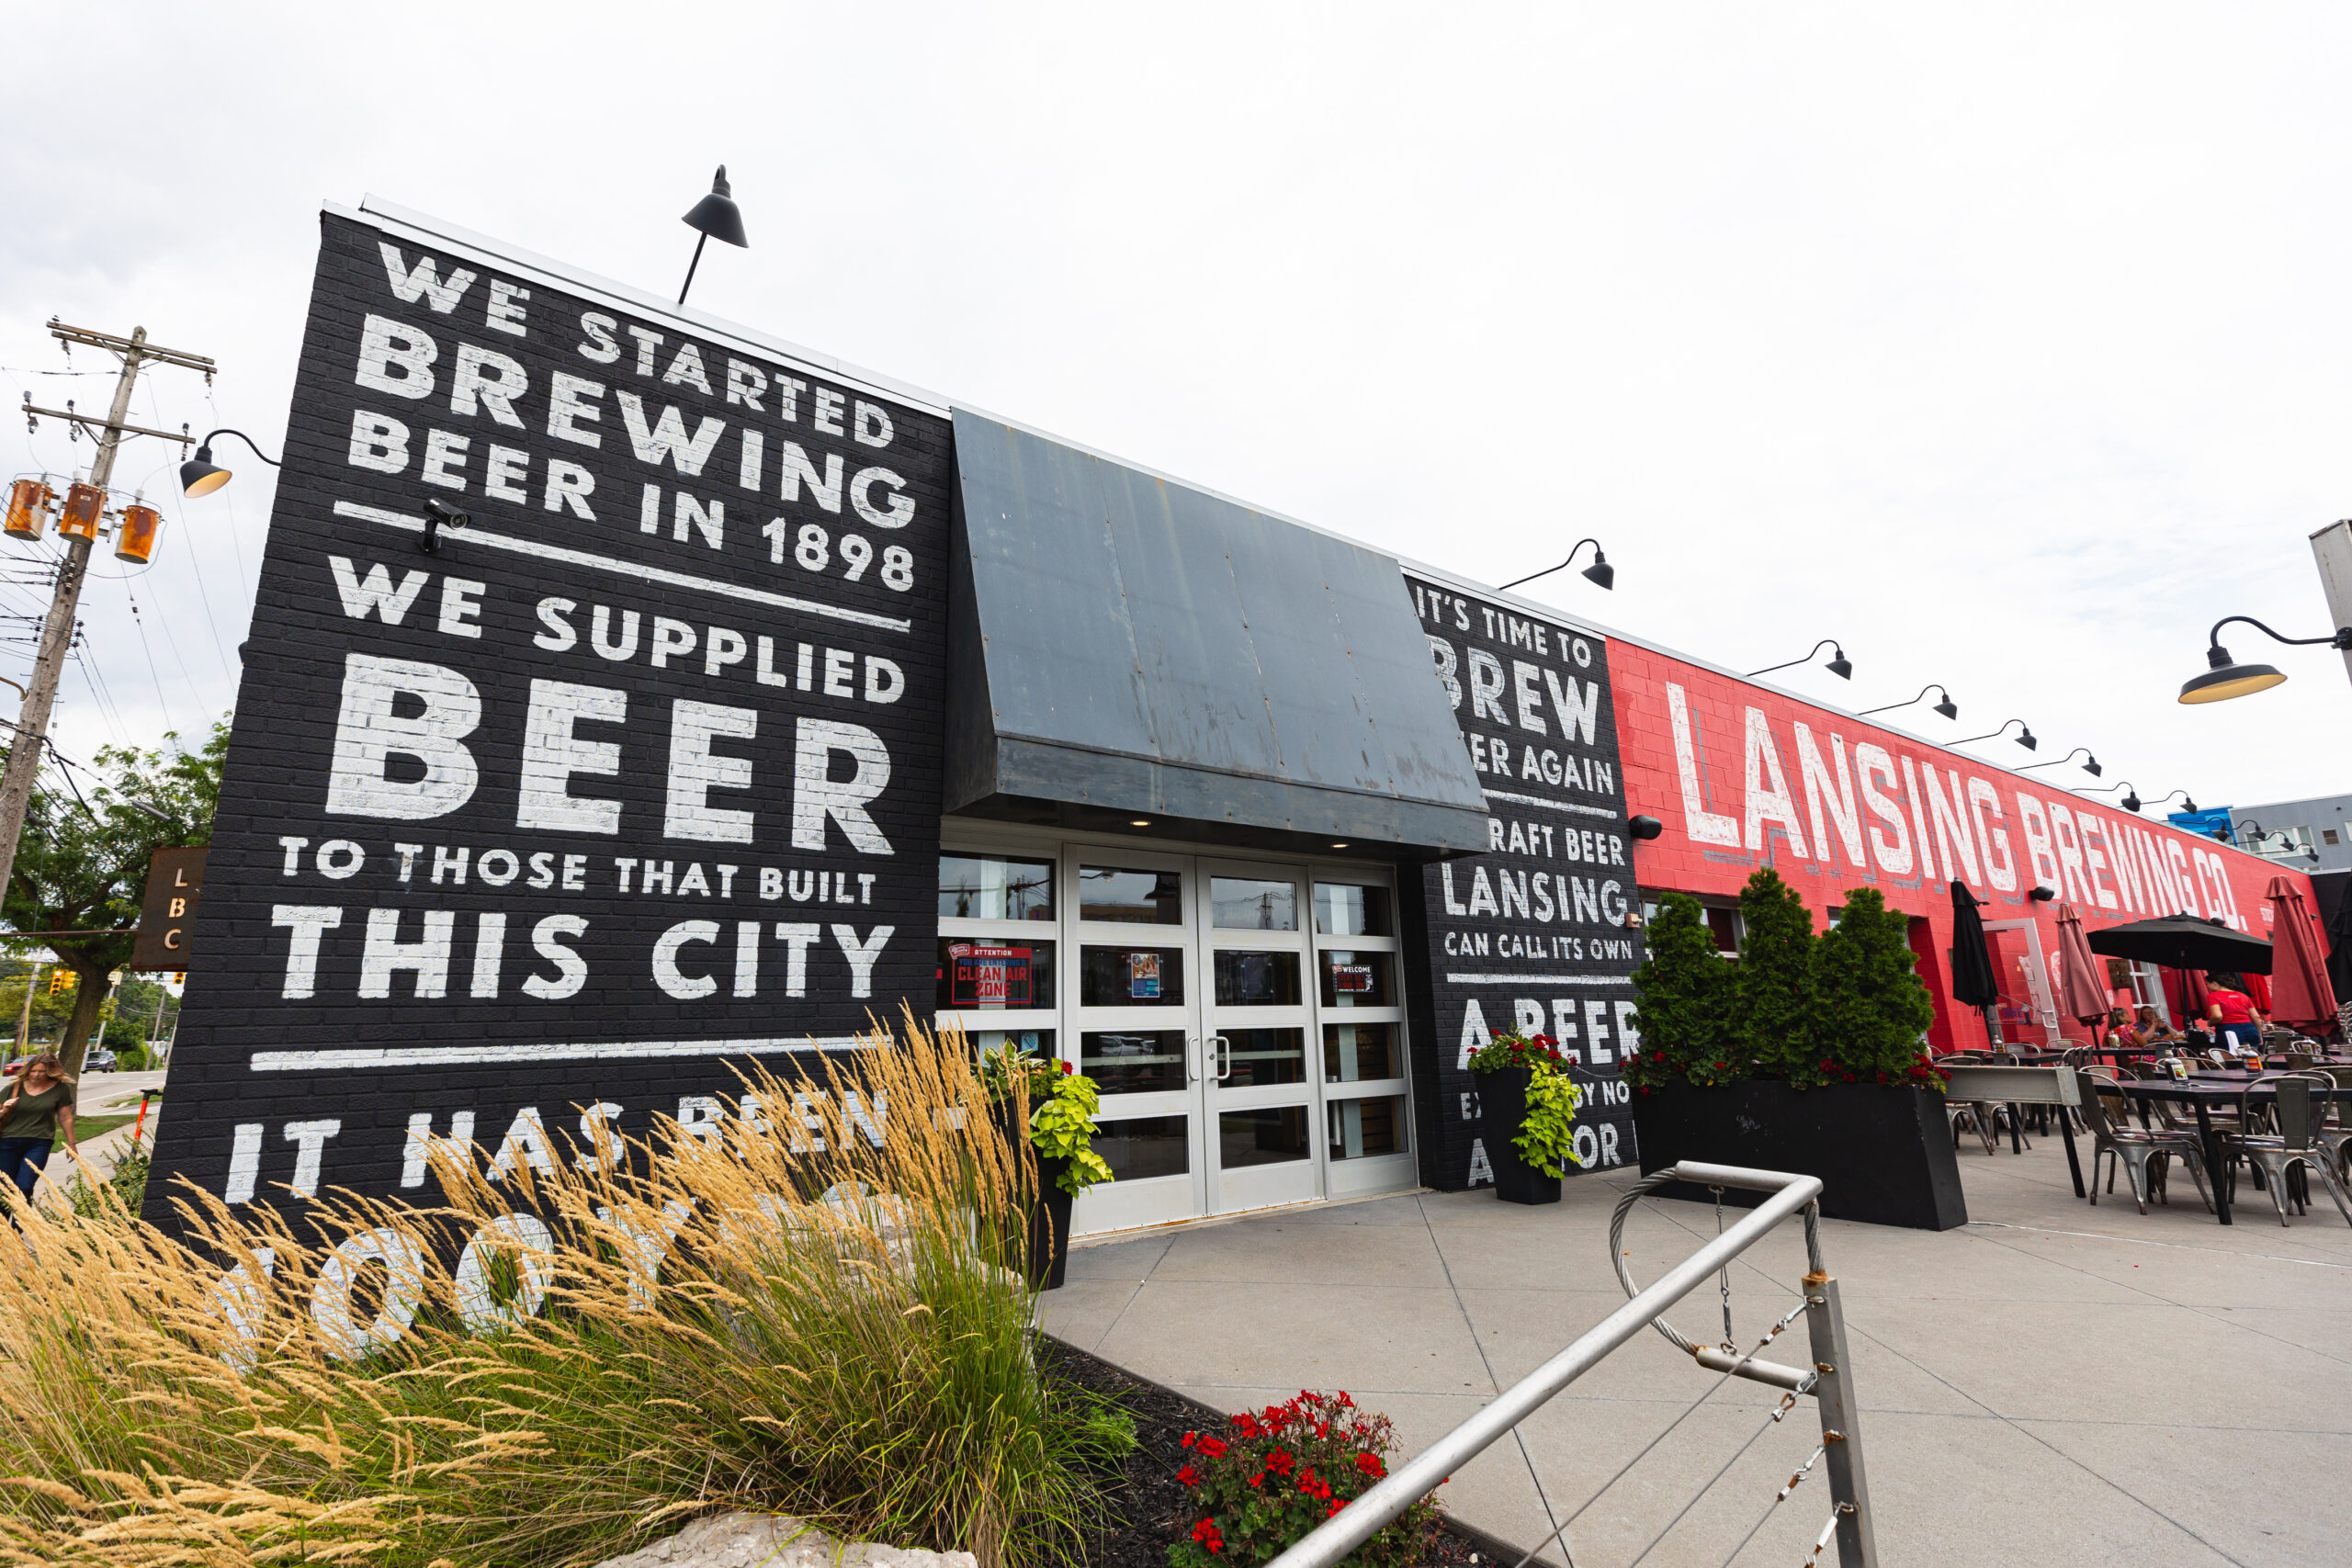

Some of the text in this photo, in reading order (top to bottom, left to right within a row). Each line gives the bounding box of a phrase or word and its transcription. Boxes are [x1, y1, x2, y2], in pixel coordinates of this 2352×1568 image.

[378, 241, 894, 448] WE STARTED
[356, 313, 917, 529] BREWING
[348, 409, 914, 592] BEER IN 1898
[328, 555, 906, 705] WE SUPPLIED
[1416, 586, 1592, 668] IT'S TIME TO
[1424, 633, 1599, 746] BREW
[325, 652, 895, 856] BEER
[1463, 731, 1614, 795] ER AGAIN
[1488, 818, 1625, 866] RAFT BEER
[1666, 682, 2249, 932] LANSING BREWING CO.
[278, 836, 876, 905] TO THOSE THAT BUILT
[1442, 863, 1628, 928] LANSING
[272, 905, 896, 999] THIS CITY
[957, 966, 1027, 981] CLEAN AIR
[1444, 931, 1633, 961] CAN CALL ITS OWN
[975, 982, 1012, 997] ZONE
[1456, 998, 1641, 1070] A BEER
[225, 1119, 341, 1204] IT
[400, 1101, 625, 1192] HAS
[1562, 1122, 1623, 1171] OR
